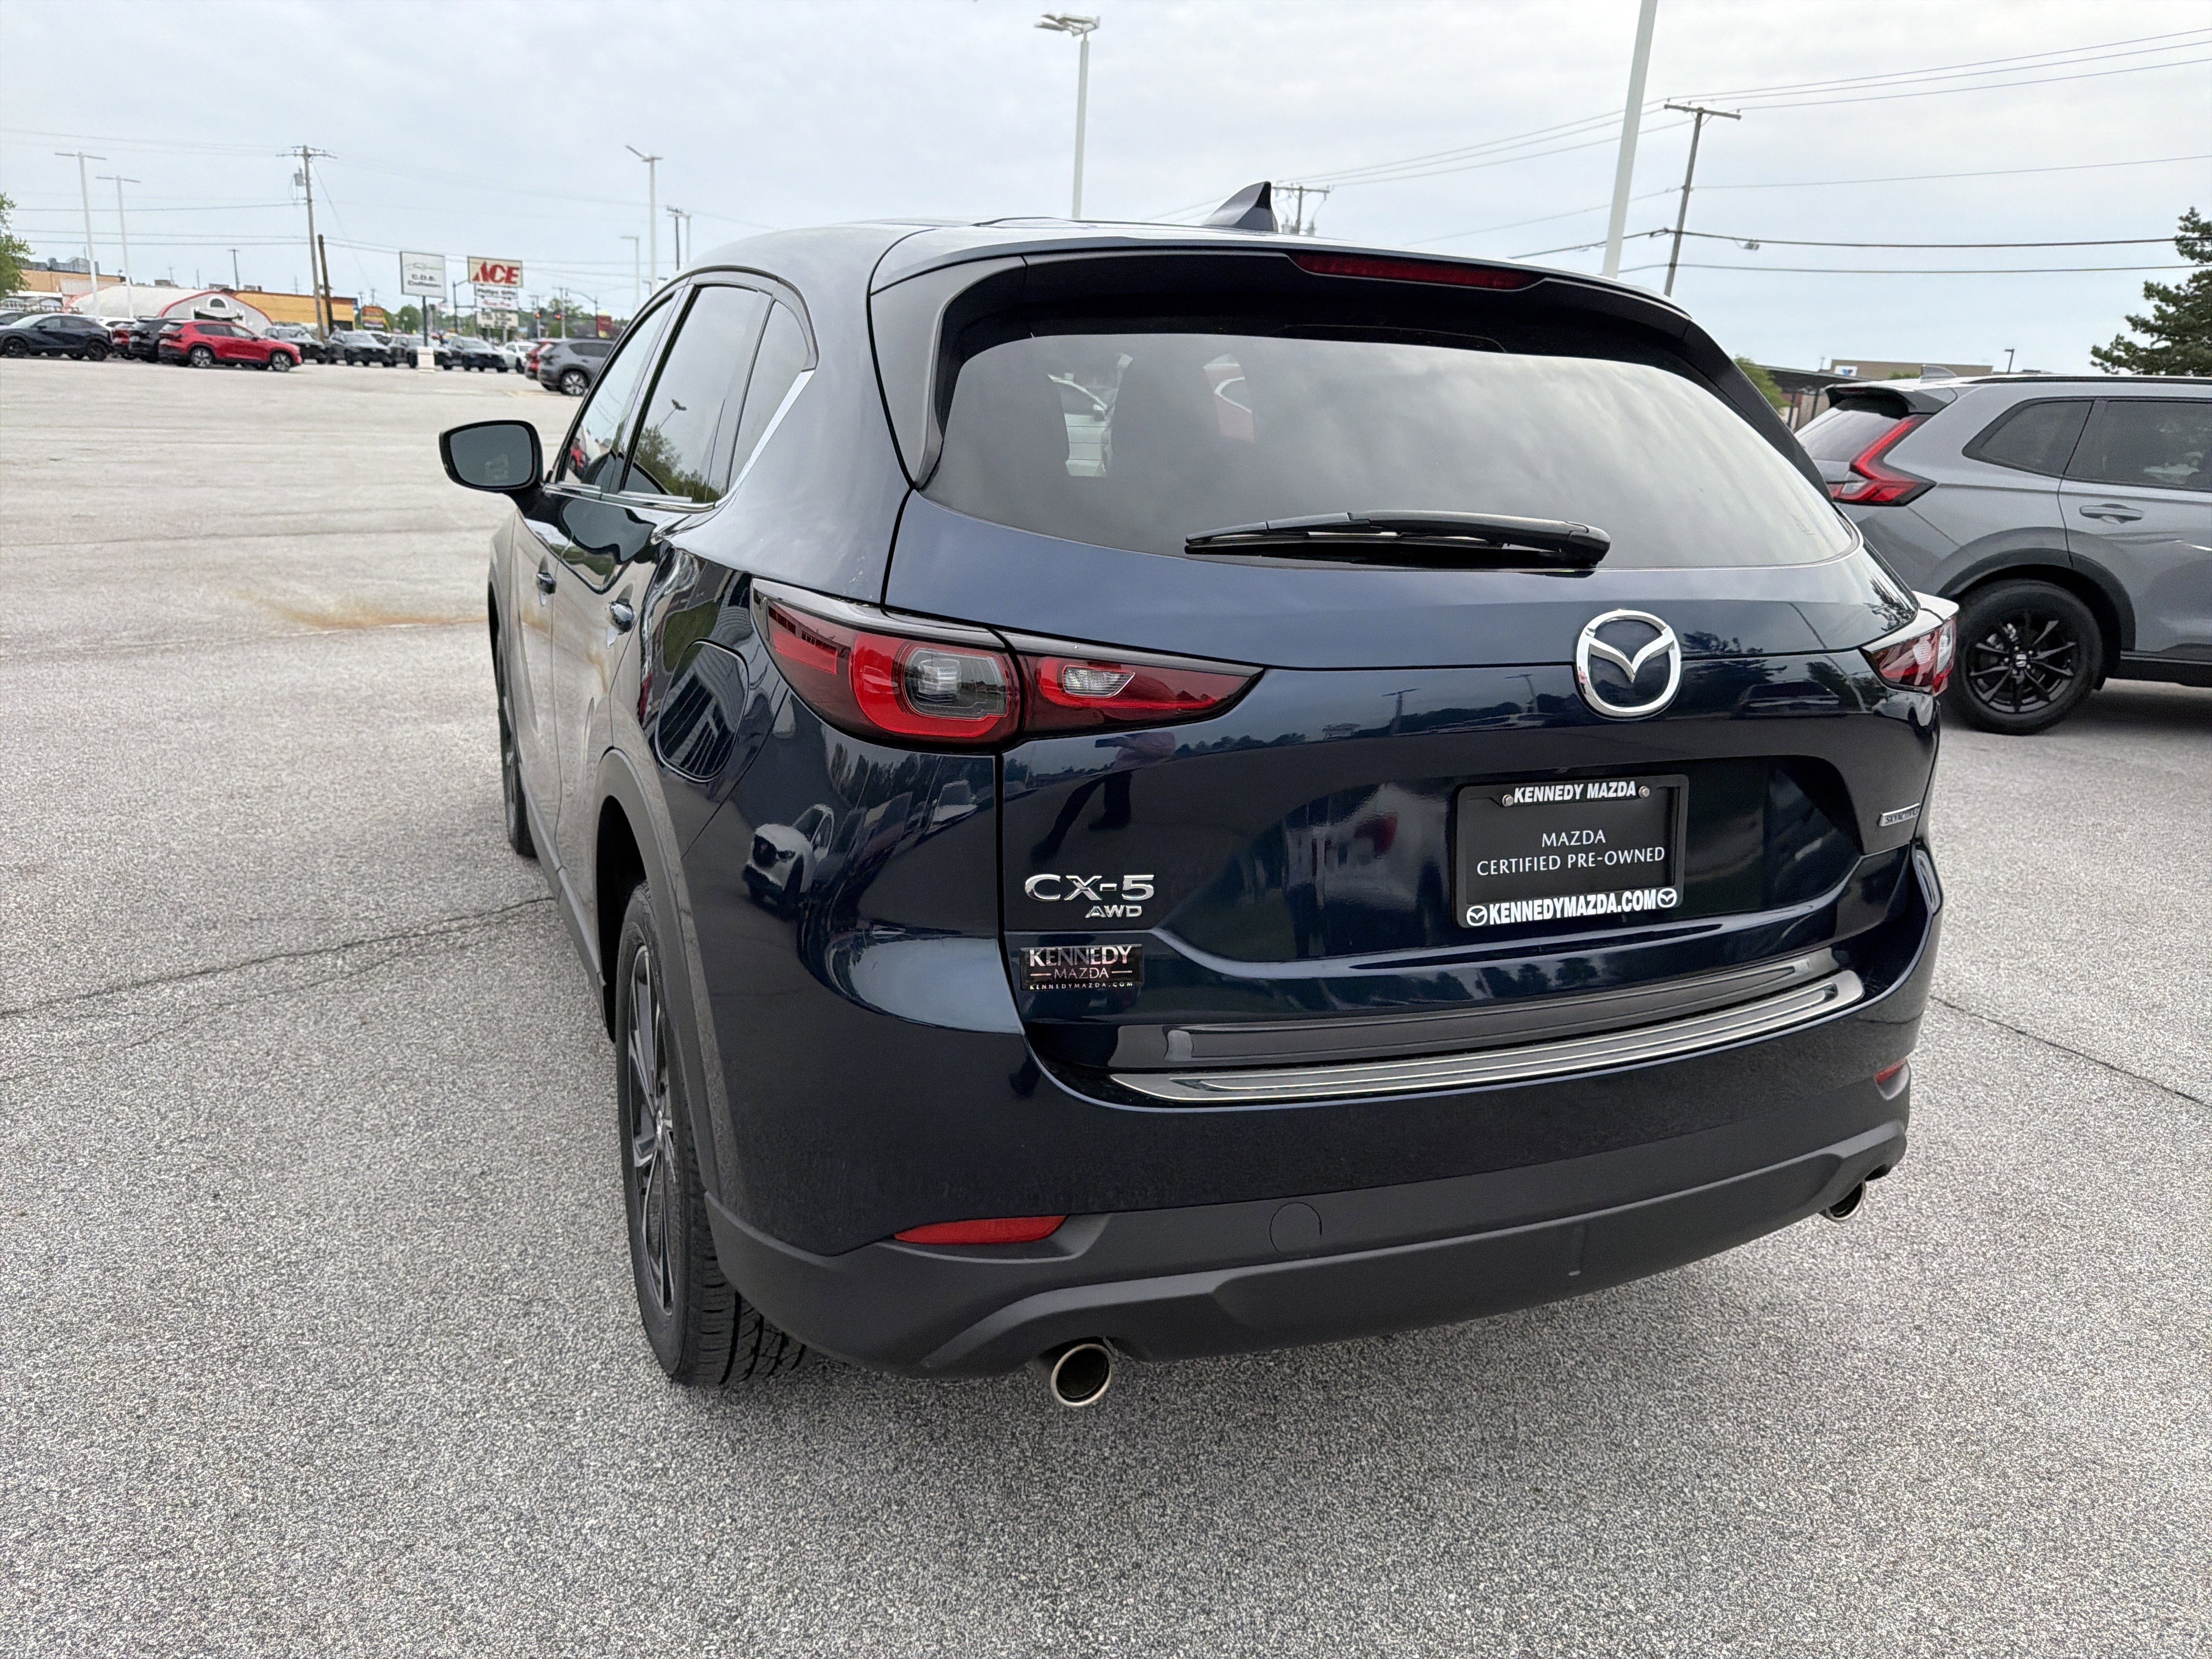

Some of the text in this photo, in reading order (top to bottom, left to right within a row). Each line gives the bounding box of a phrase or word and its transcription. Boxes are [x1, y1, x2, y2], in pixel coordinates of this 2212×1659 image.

[472, 261, 521, 284] ACE
[1514, 781, 1636, 803] KENNEDY MAZDA
[1542, 830, 1606, 848] MAZDA
[1477, 847, 1665, 876] CERTIFIED PRE-OWNED
[1025, 874, 1154, 901] CX-5
[1085, 905, 1142, 918] AWD
[1489, 889, 1656, 925] KENNEDYMAZDA.COM
[1030, 945, 1133, 967] KENNEDY
[1054, 967, 1109, 979] MAZDA
[1030, 981, 1133, 990] KENNEDYMAZDA.COM
